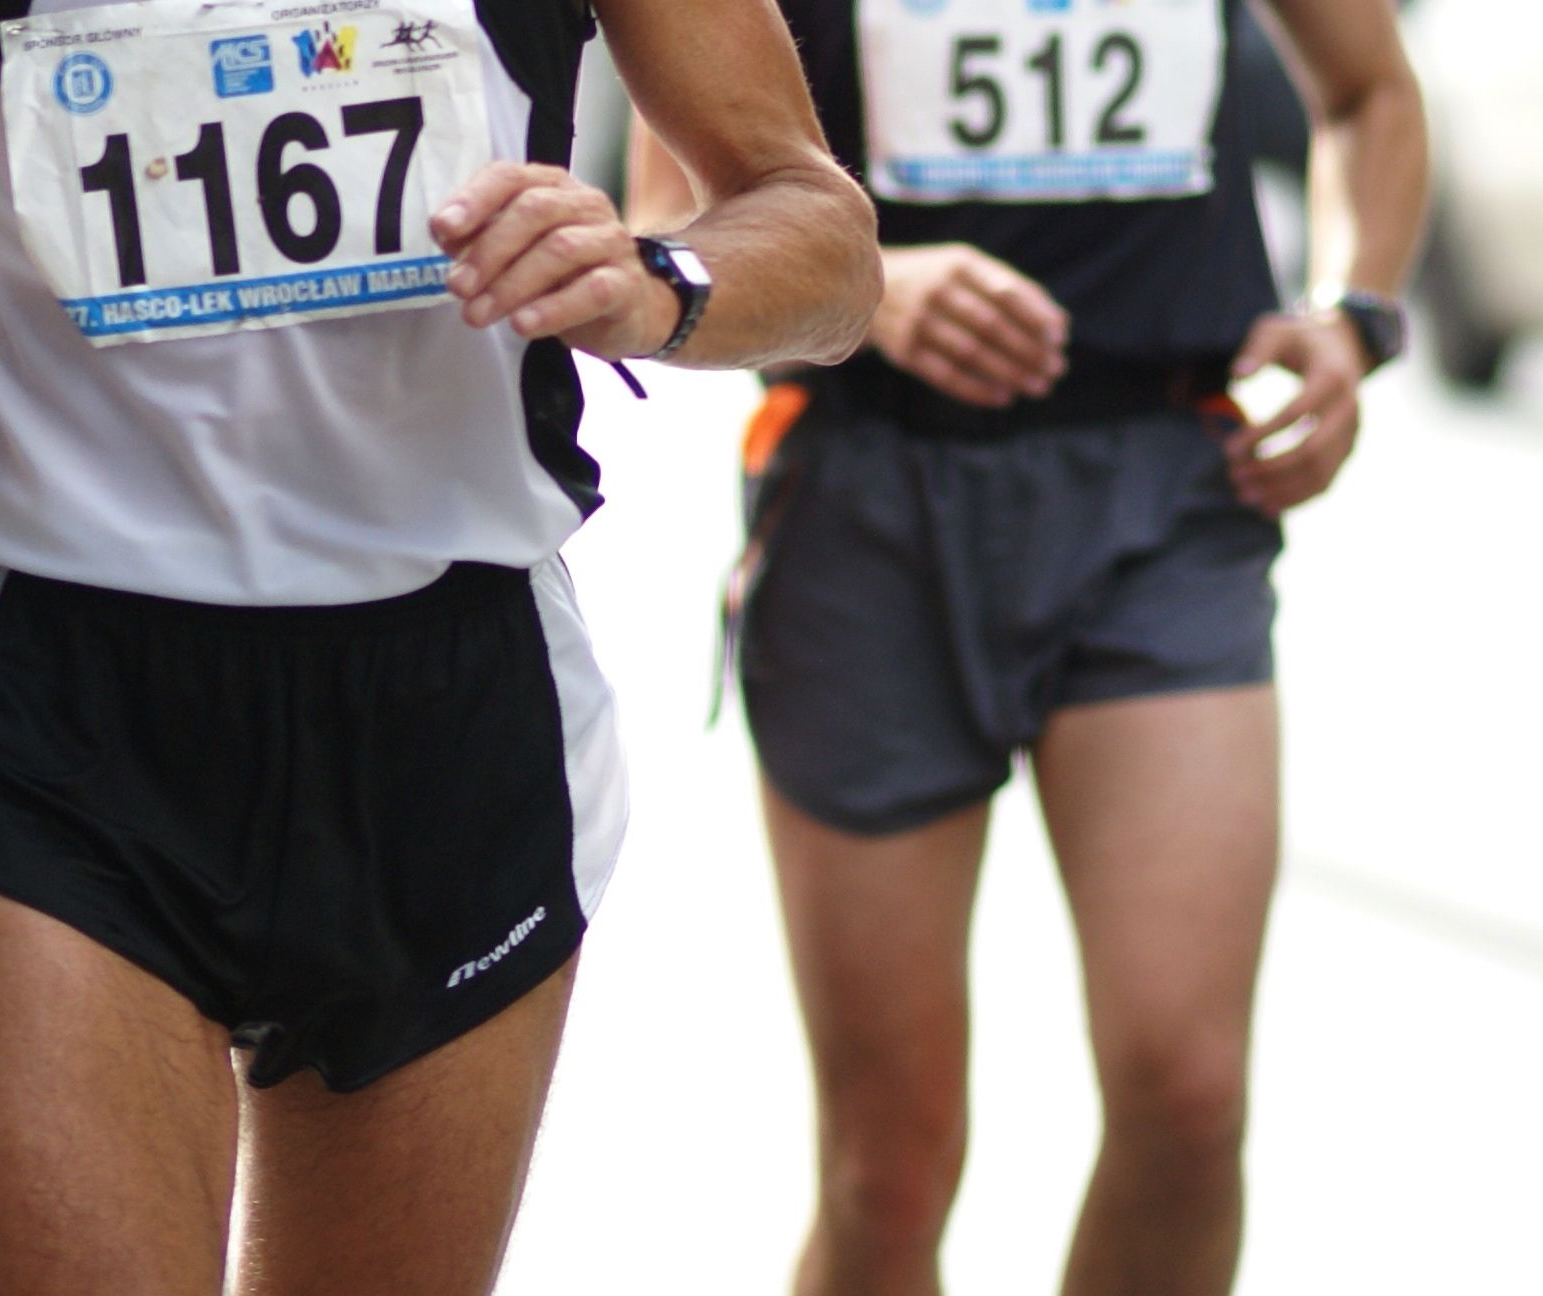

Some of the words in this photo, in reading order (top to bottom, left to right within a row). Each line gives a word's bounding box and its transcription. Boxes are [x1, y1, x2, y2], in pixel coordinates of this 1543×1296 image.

[947, 30, 1147, 149] 512
[80, 96, 424, 288] 1167
[101, 290, 235, 326] HASCO-LEK
